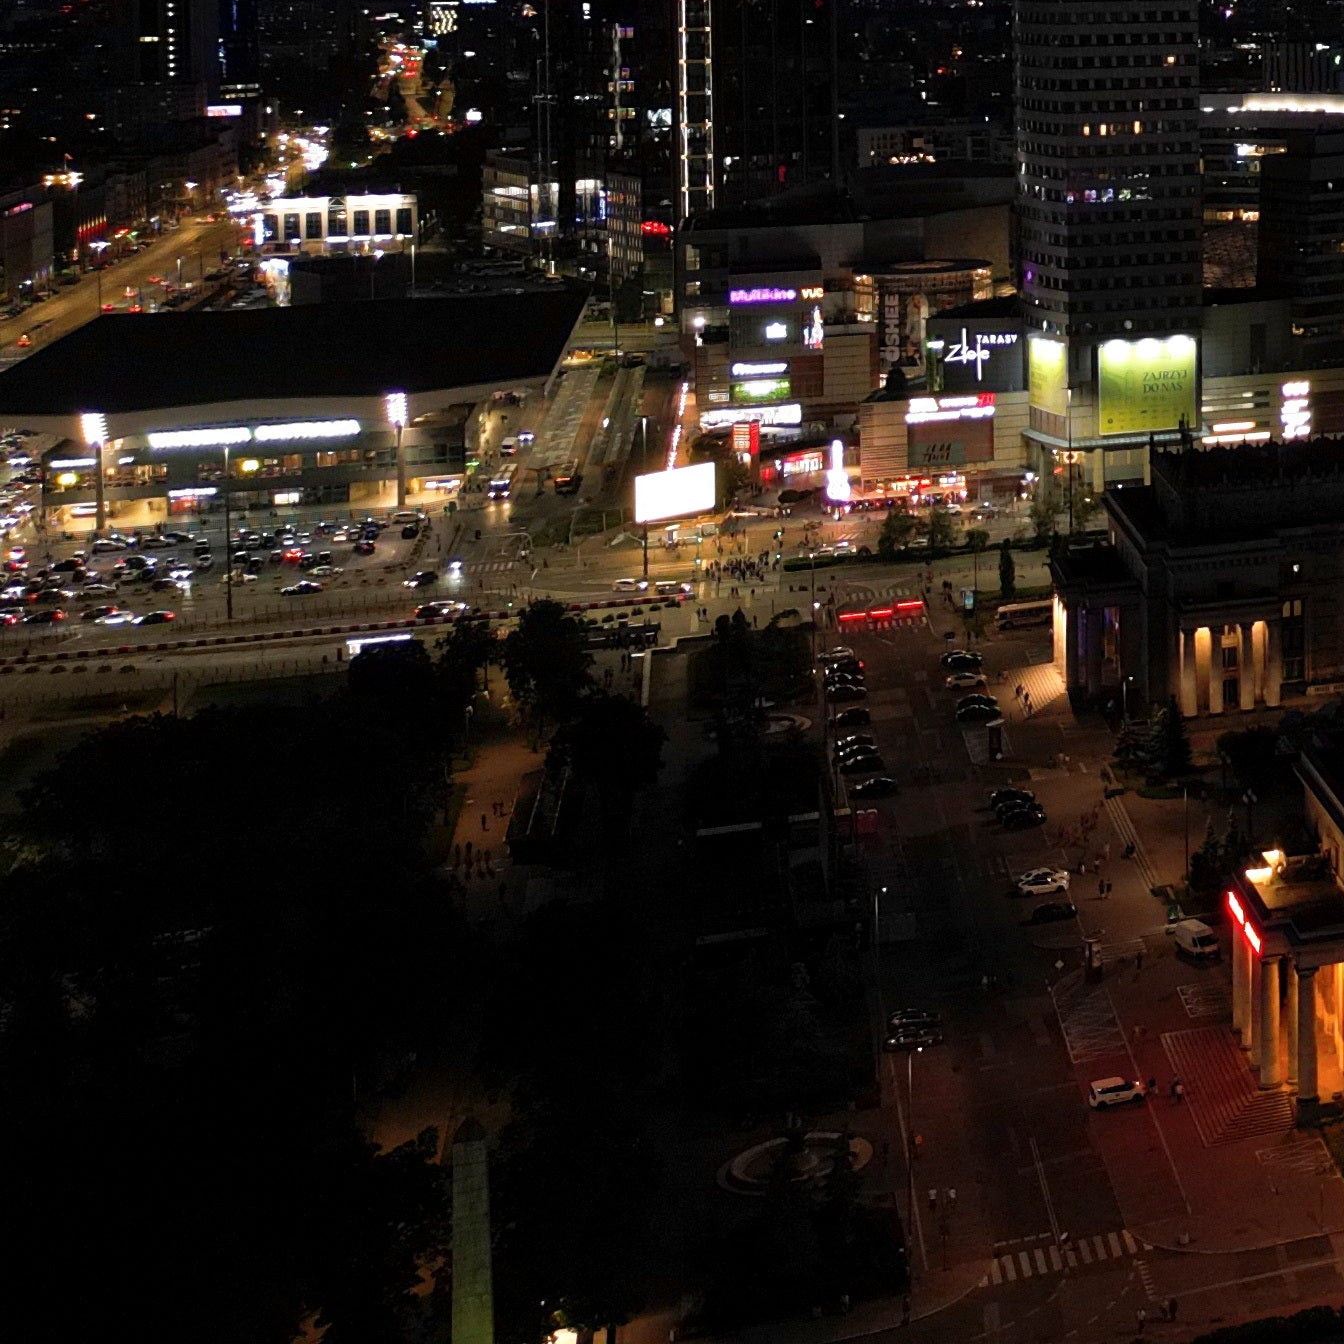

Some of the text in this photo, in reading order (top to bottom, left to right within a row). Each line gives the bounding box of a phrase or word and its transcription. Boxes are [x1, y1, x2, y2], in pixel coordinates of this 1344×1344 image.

[976, 334, 1018, 344] TARASY
[1143, 369, 1188, 382] ZAJRZYJ
[1143, 382, 1184, 394] DO NAS
